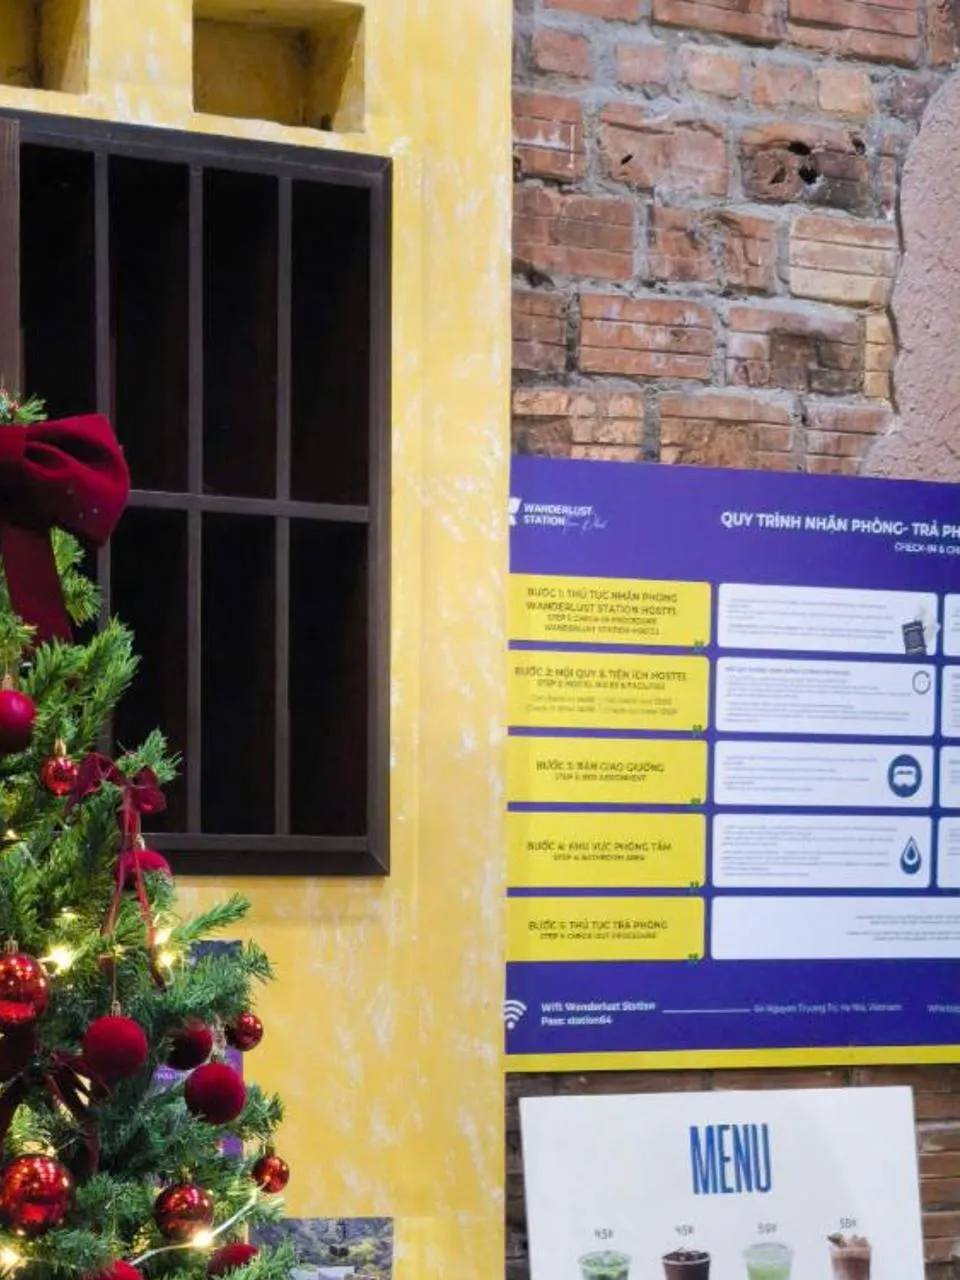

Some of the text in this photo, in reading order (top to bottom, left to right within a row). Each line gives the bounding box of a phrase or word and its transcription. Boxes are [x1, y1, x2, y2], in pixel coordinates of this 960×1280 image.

[523, 503, 593, 517] WANDERLUST
[523, 514, 566, 526] STATION
[721, 511, 753, 529] QUY
[755, 511, 801, 529] TRÌNH
[942, 524, 960, 538] PH
[622, 1000, 656, 1011] Station
[690, 1123, 772, 1195] MENU
